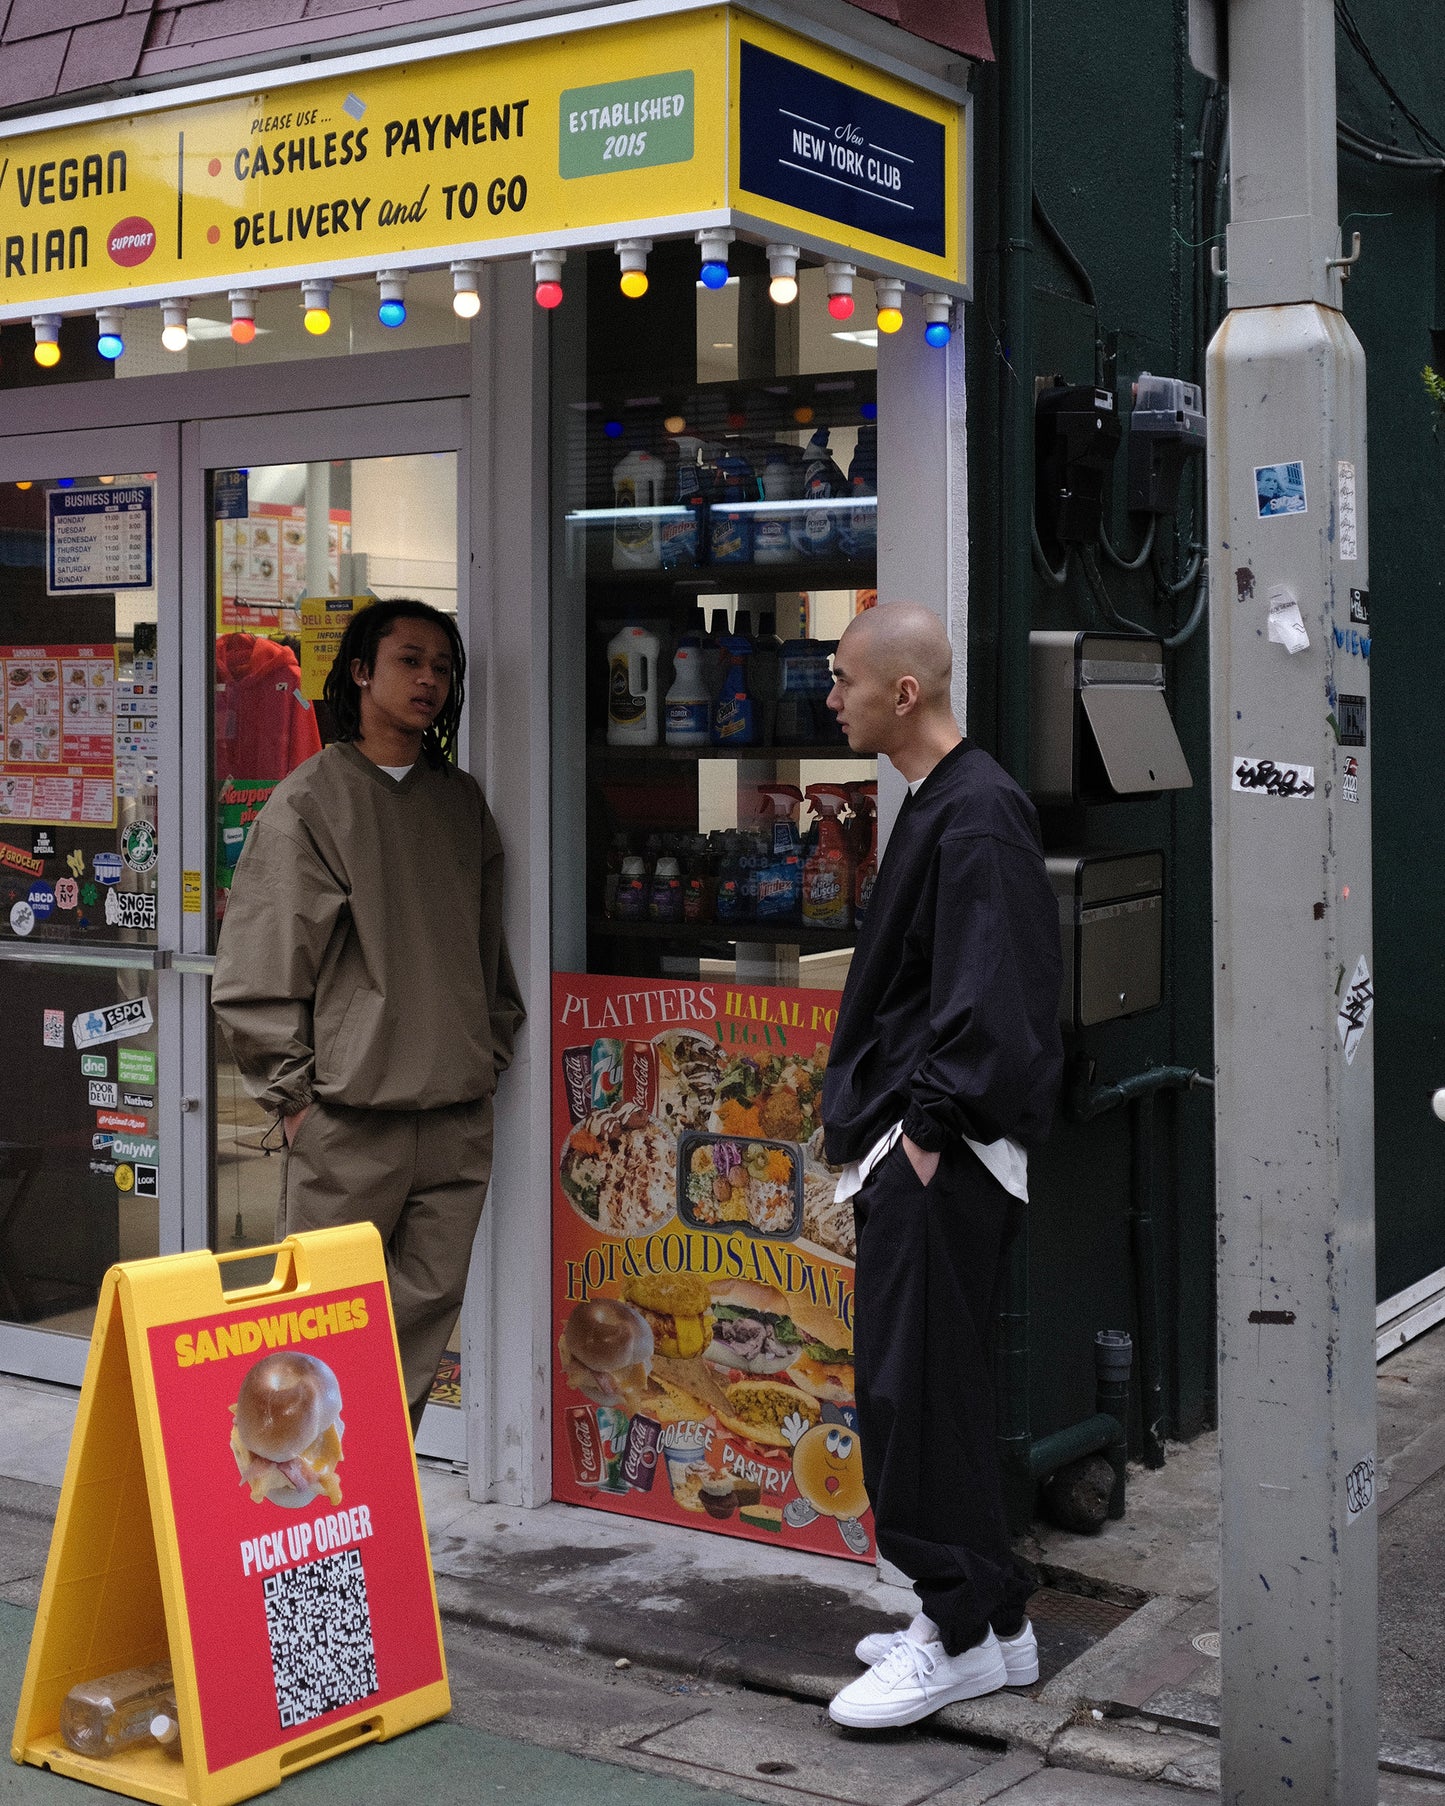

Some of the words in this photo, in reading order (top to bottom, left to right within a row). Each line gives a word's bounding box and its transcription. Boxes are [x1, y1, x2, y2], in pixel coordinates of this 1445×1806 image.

[250, 112, 293, 134] PLEASE
[569, 93, 685, 134] ESTABLISHED
[233, 126, 368, 180] CASHLESS
[384, 99, 530, 158] PAYMENT
[834, 123, 865, 147] New
[602, 131, 647, 160] 2015
[792, 128, 825, 163] NEW
[828, 141, 865, 178] YORK
[867, 158, 902, 191] CLUB
[16, 150, 127, 208] VEGAN
[233, 196, 373, 251] DELIVERY
[377, 184, 432, 229] and
[441, 181, 478, 220] TO
[486, 174, 529, 216] GO
[4, 225, 88, 278] RIAN
[111, 232, 154, 251] SUPPORT
[64, 493, 110, 507] BUSINESS
[112, 490, 145, 504] HOURS
[57, 516, 85, 524] MONDAY
[57, 526, 86, 534] TUESDAY
[57, 536, 97, 544] WEDNESDAY
[662, 521, 697, 542] Windex
[57, 556, 80, 564] FRIDAY
[57, 566, 91, 574] SATURDAY
[57, 575, 84, 584] SUNDAY
[302, 615, 321, 625] DELI
[324, 615, 332, 624] &
[316, 632, 344, 640] INFOM
[33, 846, 55, 854] SPECIAL
[5, 850, 41, 871] GROCERY
[28, 892, 54, 904] ABCD
[60, 893, 74, 903] NY
[759, 880, 792, 900] Windex
[106, 1003, 142, 1025] ESPO
[559, 986, 717, 1030] PLATTERS
[724, 991, 806, 1030] HALAL
[715, 1021, 787, 1047] VEGAN
[83, 1058, 105, 1073] dnc
[90, 1082, 113, 1094] POOR
[90, 1092, 116, 1103] DEVIL
[124, 1095, 154, 1108] Natives
[113, 1140, 156, 1158] OnlyNY
[725, 1236, 855, 1345] SANDWIC
[174, 1298, 369, 1368] SANDWICHES
[656, 1420, 717, 1454] COFFEE
[722, 1444, 793, 1493] PASTRY
[240, 1530, 288, 1577] PICK
[287, 1522, 313, 1561] UP
[313, 1504, 374, 1553] ORDER
